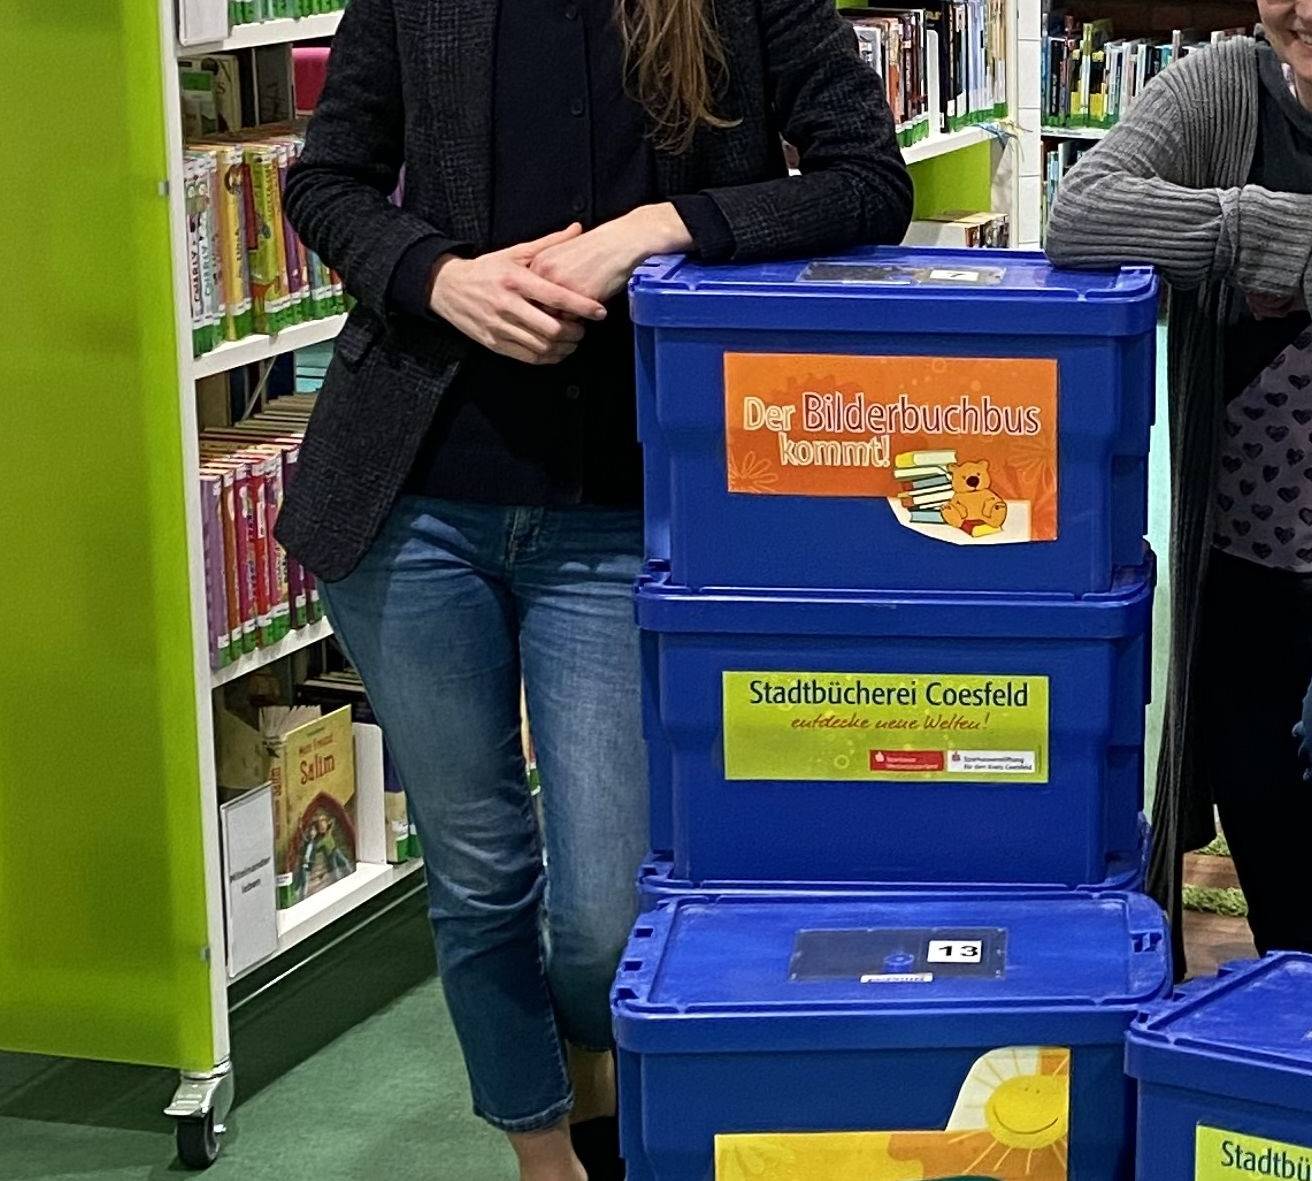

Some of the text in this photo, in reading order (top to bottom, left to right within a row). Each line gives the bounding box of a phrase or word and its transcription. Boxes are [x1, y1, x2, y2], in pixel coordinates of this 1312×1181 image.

[743, 391, 1042, 435] Der Bilderbuchbus
[778, 431, 890, 467] kommt!
[749, 680, 1029, 706] Stadtbücherei Coesfeld
[791, 712, 990, 730] entdecke neue Welten!
[938, 945, 979, 957] 13
